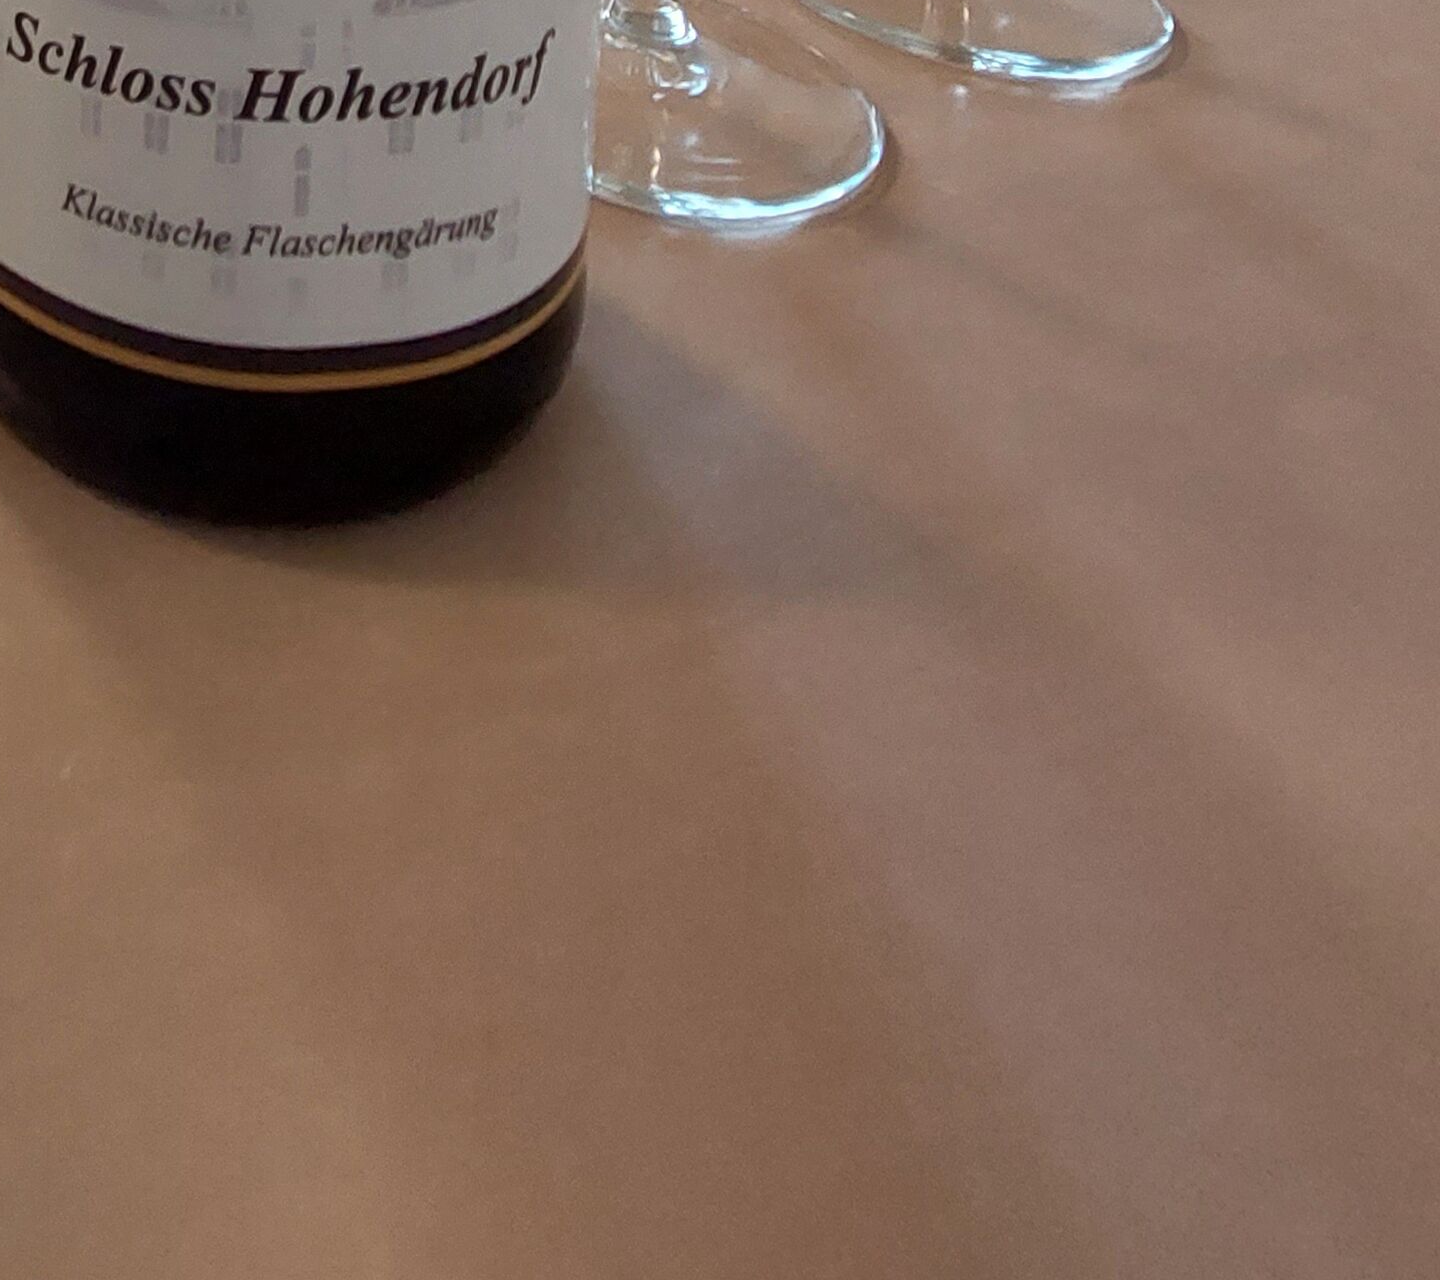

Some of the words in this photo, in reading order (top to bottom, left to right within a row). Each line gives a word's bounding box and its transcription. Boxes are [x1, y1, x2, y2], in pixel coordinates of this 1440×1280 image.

[6, 11, 217, 118] Schloss
[233, 26, 557, 126] Hohendorf
[62, 182, 233, 256] Klassische
[241, 205, 500, 262] Flaschengärung
